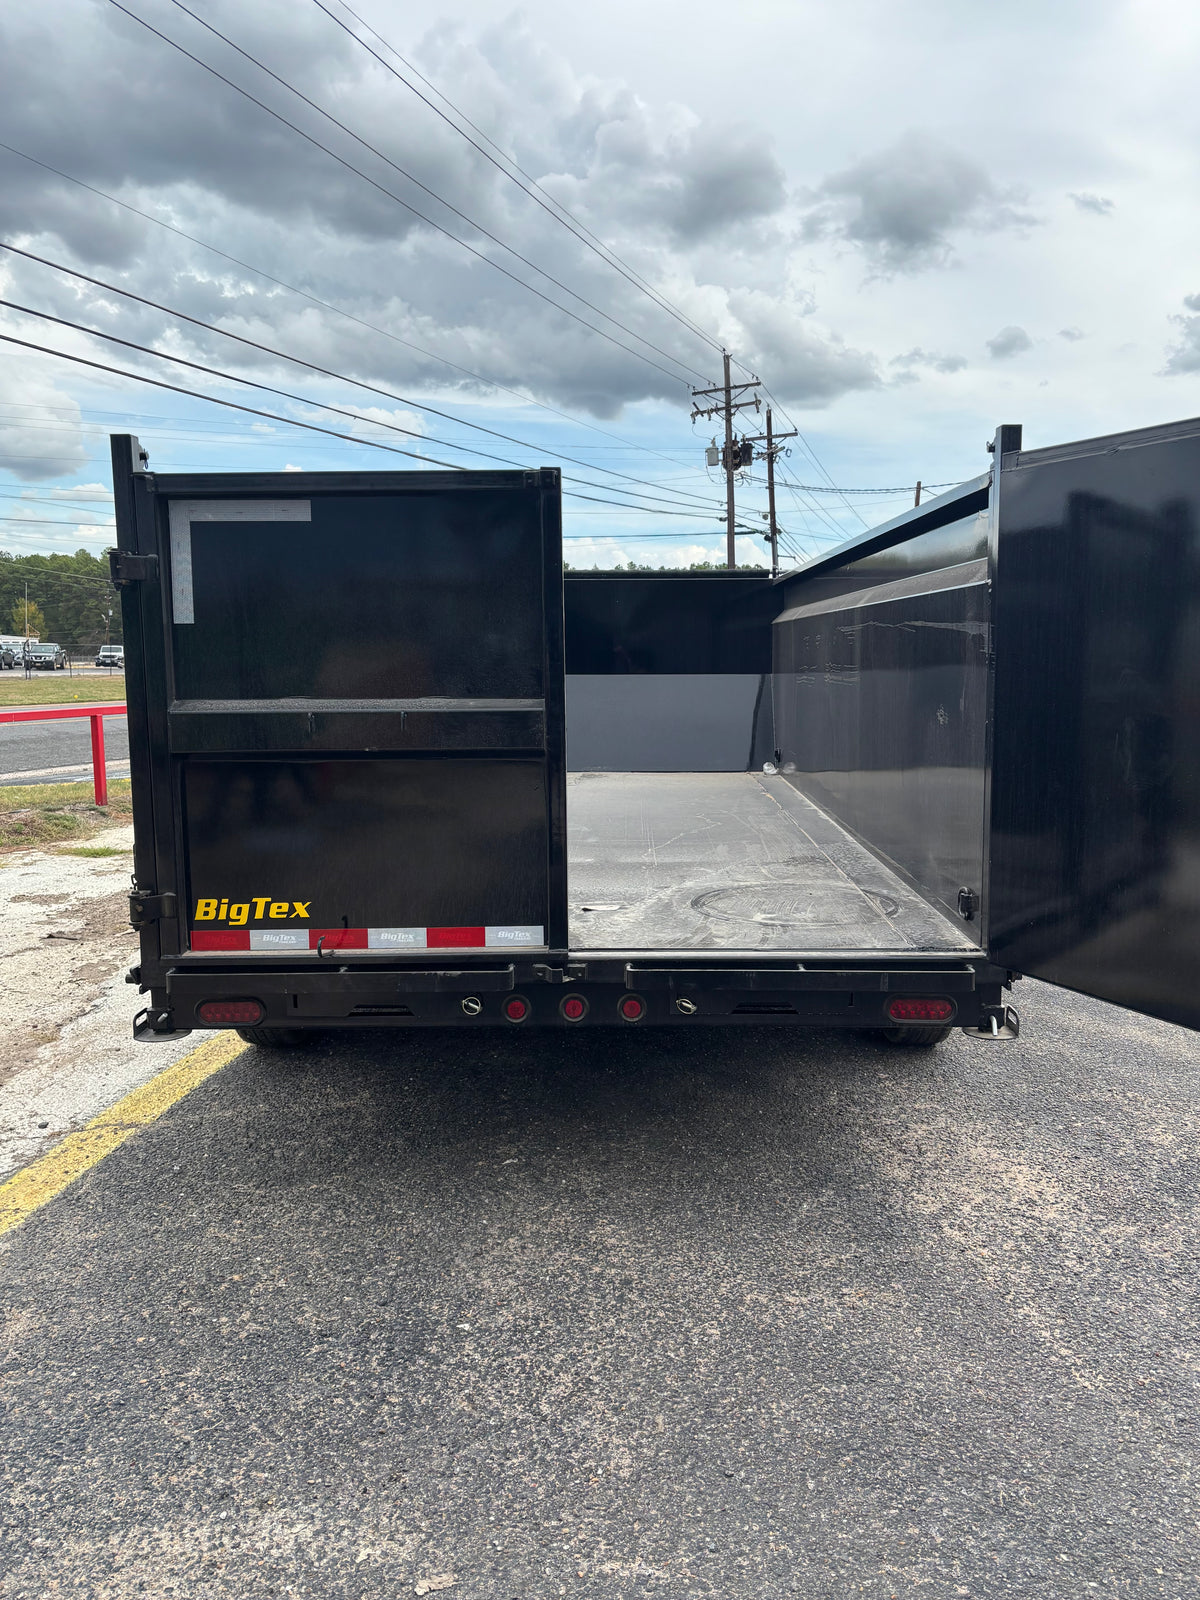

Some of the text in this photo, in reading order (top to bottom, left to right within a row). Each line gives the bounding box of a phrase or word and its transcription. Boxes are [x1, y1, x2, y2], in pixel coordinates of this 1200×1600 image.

[194, 897, 312, 926] BigTex
[262, 934, 296, 942] BigTex
[380, 932, 414, 941] BigTex
[497, 930, 530, 939] BigTex
